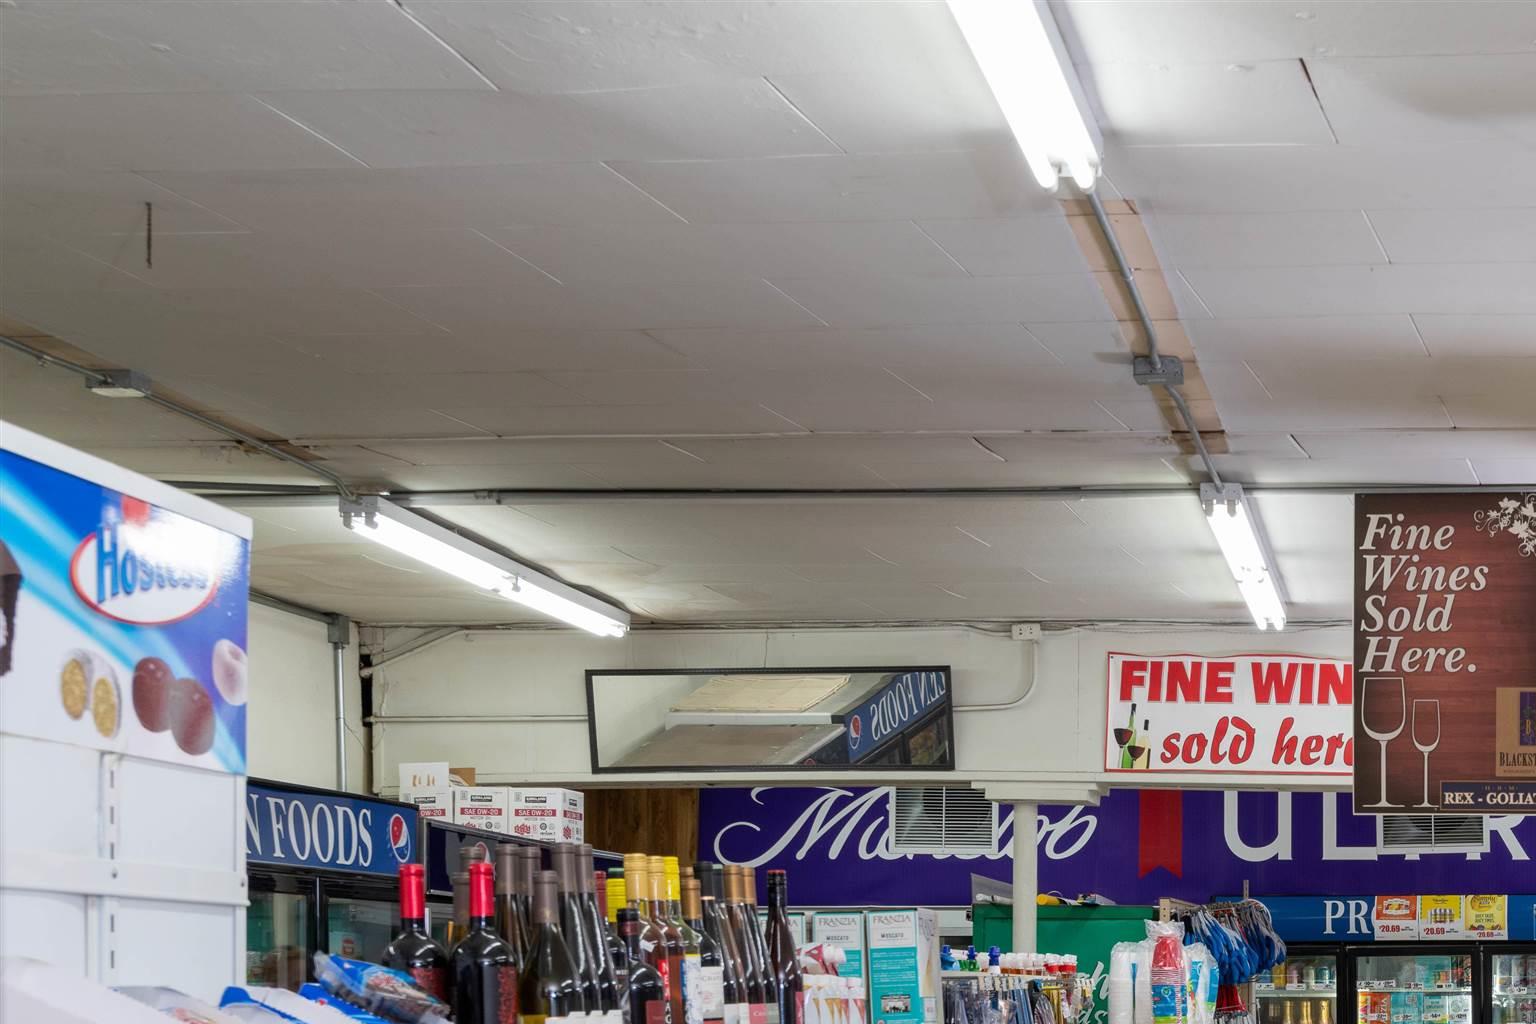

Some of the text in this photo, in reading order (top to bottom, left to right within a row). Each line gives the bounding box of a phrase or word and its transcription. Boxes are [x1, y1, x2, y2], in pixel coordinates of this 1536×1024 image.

[1359, 513, 1455, 551] Fine
[1362, 554, 1489, 592] Wines
[1360, 594, 1453, 632] Sold
[1358, 636, 1477, 673] Here.
[1119, 660, 1352, 705] FINE WIN
[1160, 716, 1256, 766] sold
[464, 808, 476, 816] SAE
[1444, 792, 1474, 805] REX
[266, 796, 373, 868] FOODS
[818, 917, 857, 929] FRANZIA
[872, 914, 911, 927] FRANZIA
[1323, 900, 1376, 934] PR
